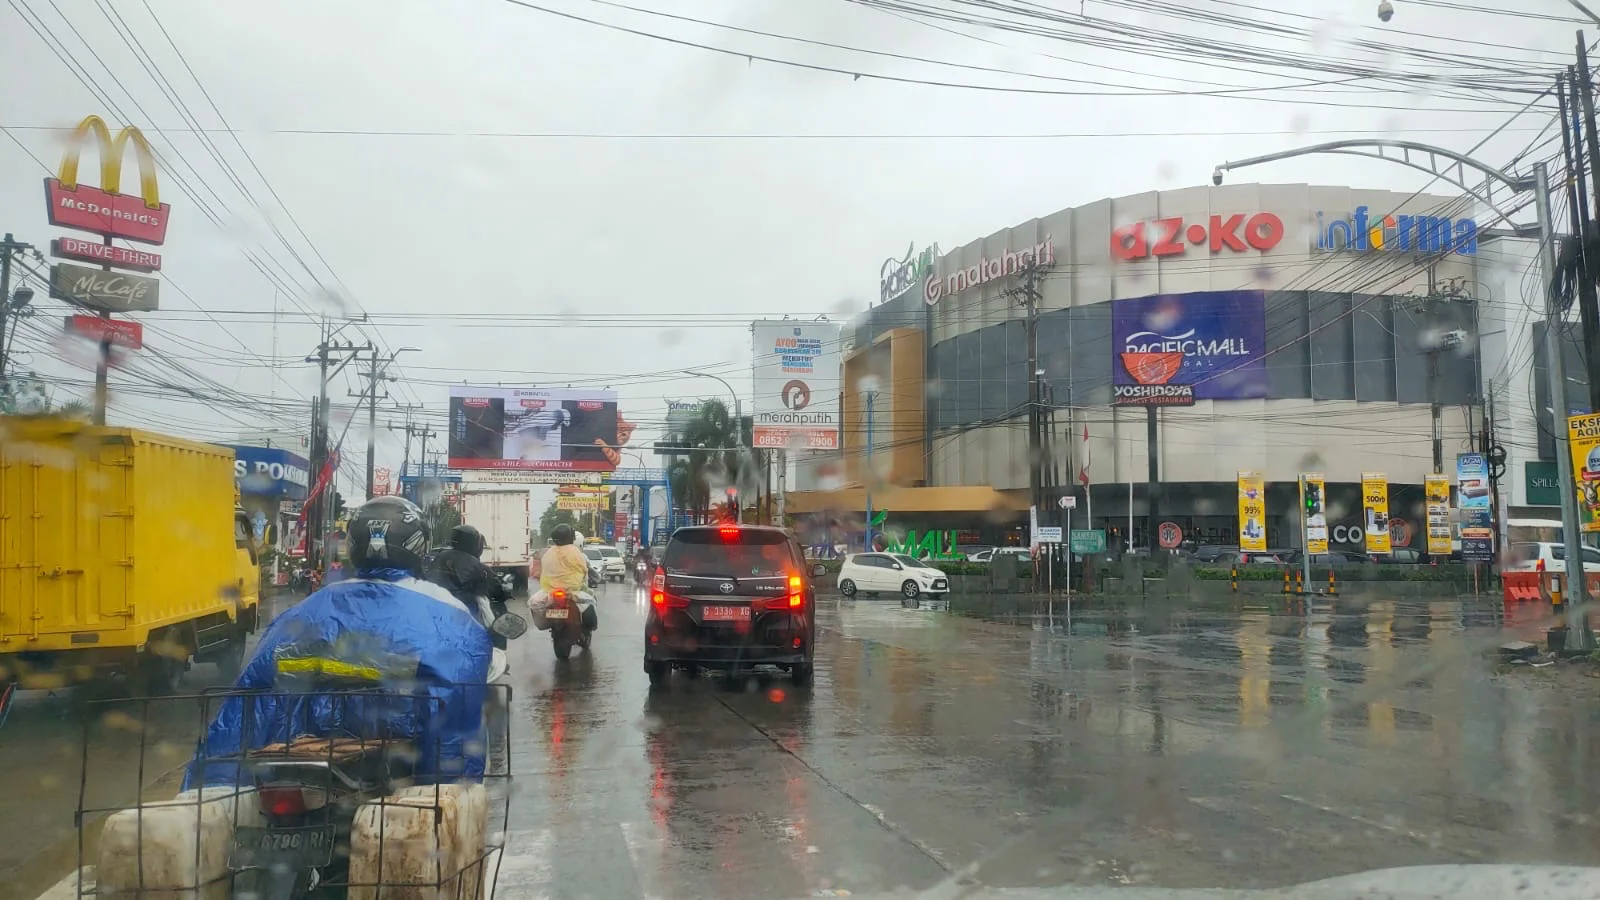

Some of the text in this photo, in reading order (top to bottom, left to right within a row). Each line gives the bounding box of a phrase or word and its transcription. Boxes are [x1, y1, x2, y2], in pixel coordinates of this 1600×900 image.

[61, 197, 159, 226] McDonald's
[1316, 205, 1478, 256] informa
[66, 240, 160, 266] DRIVE THRU
[945, 233, 1055, 296] matahari
[72, 272, 149, 305] McCafé
[1114, 385, 1193, 397] YOSHINOYA
[1150, 396, 1193, 404] RESTAURANT
[760, 412, 832, 424] merahputih
[759, 435, 782, 445] 0852
[1578, 428, 1600, 437] AQI
[1531, 478, 1560, 488] SPILLA
[1366, 495, 1386, 504] 500rb
[1330, 525, 1363, 544] .CO
[886, 528, 966, 561] MALL
